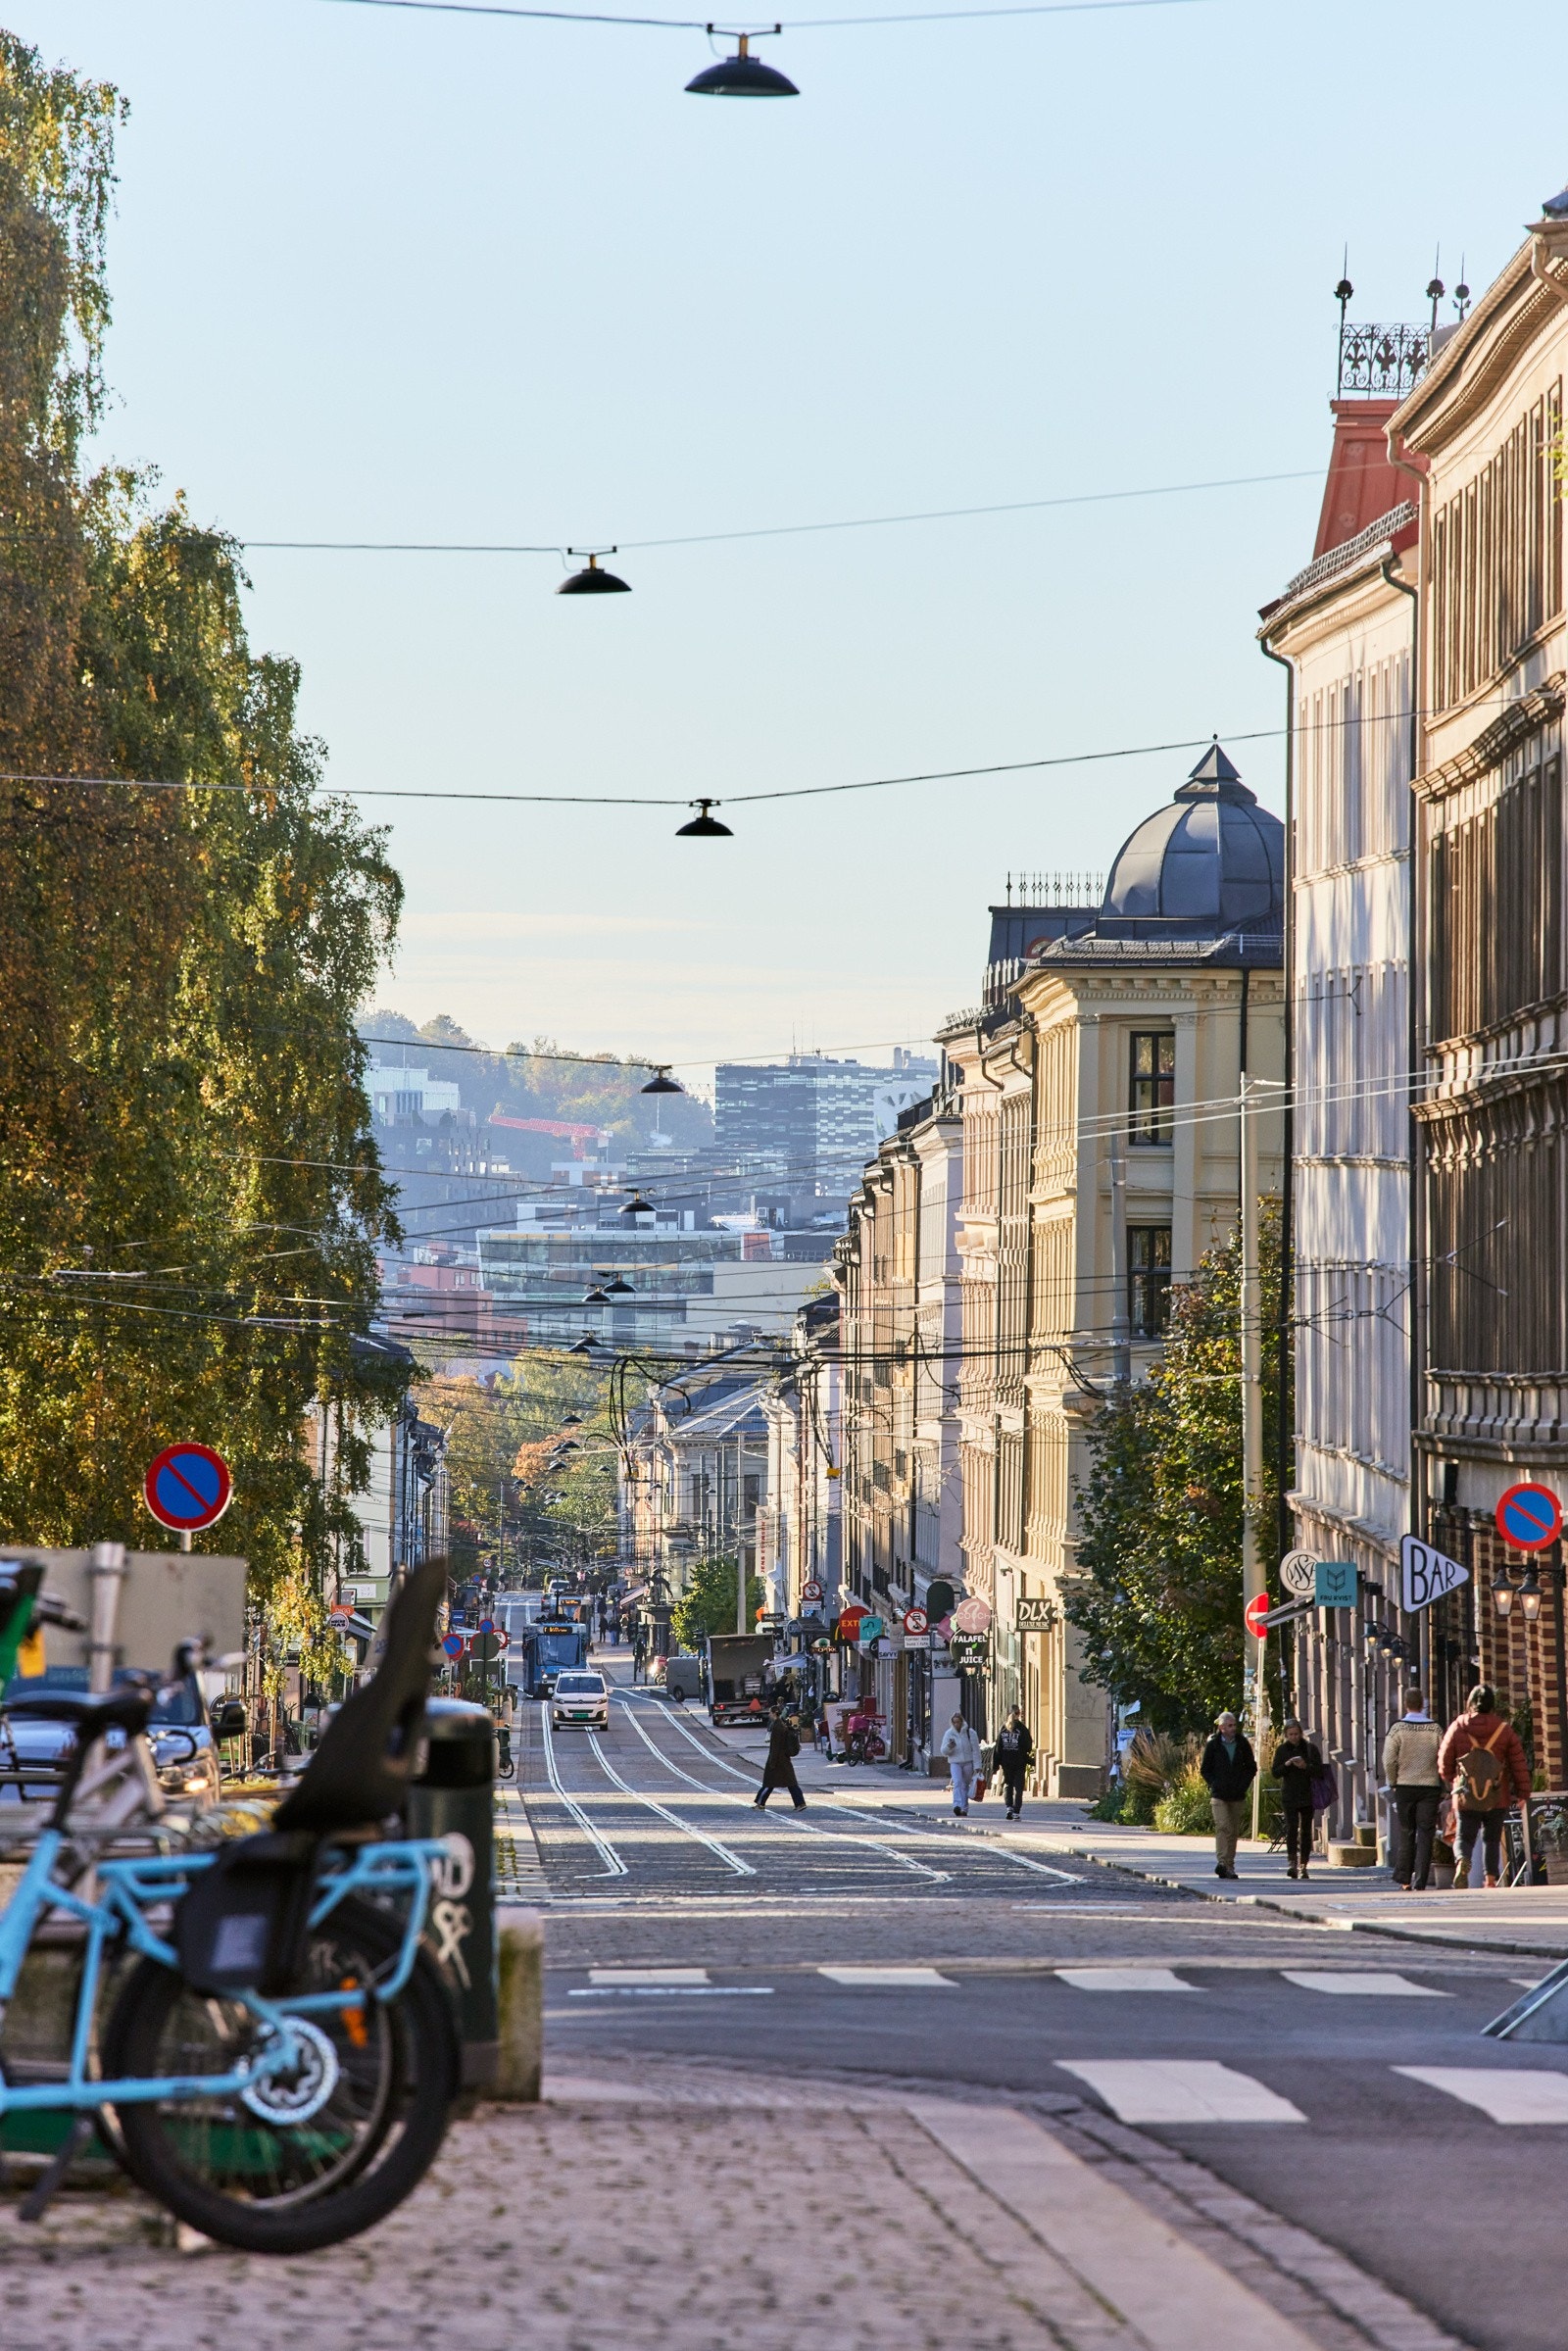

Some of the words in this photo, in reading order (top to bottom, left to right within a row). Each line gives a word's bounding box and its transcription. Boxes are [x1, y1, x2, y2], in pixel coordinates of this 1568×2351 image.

[1411, 1544, 1455, 1604] BAR
[1019, 1601, 1051, 1621] DLX
[841, 1619, 861, 1628] EXT
[954, 1635, 987, 1643] FALAFEL
[958, 1655, 983, 1664] JUICE
